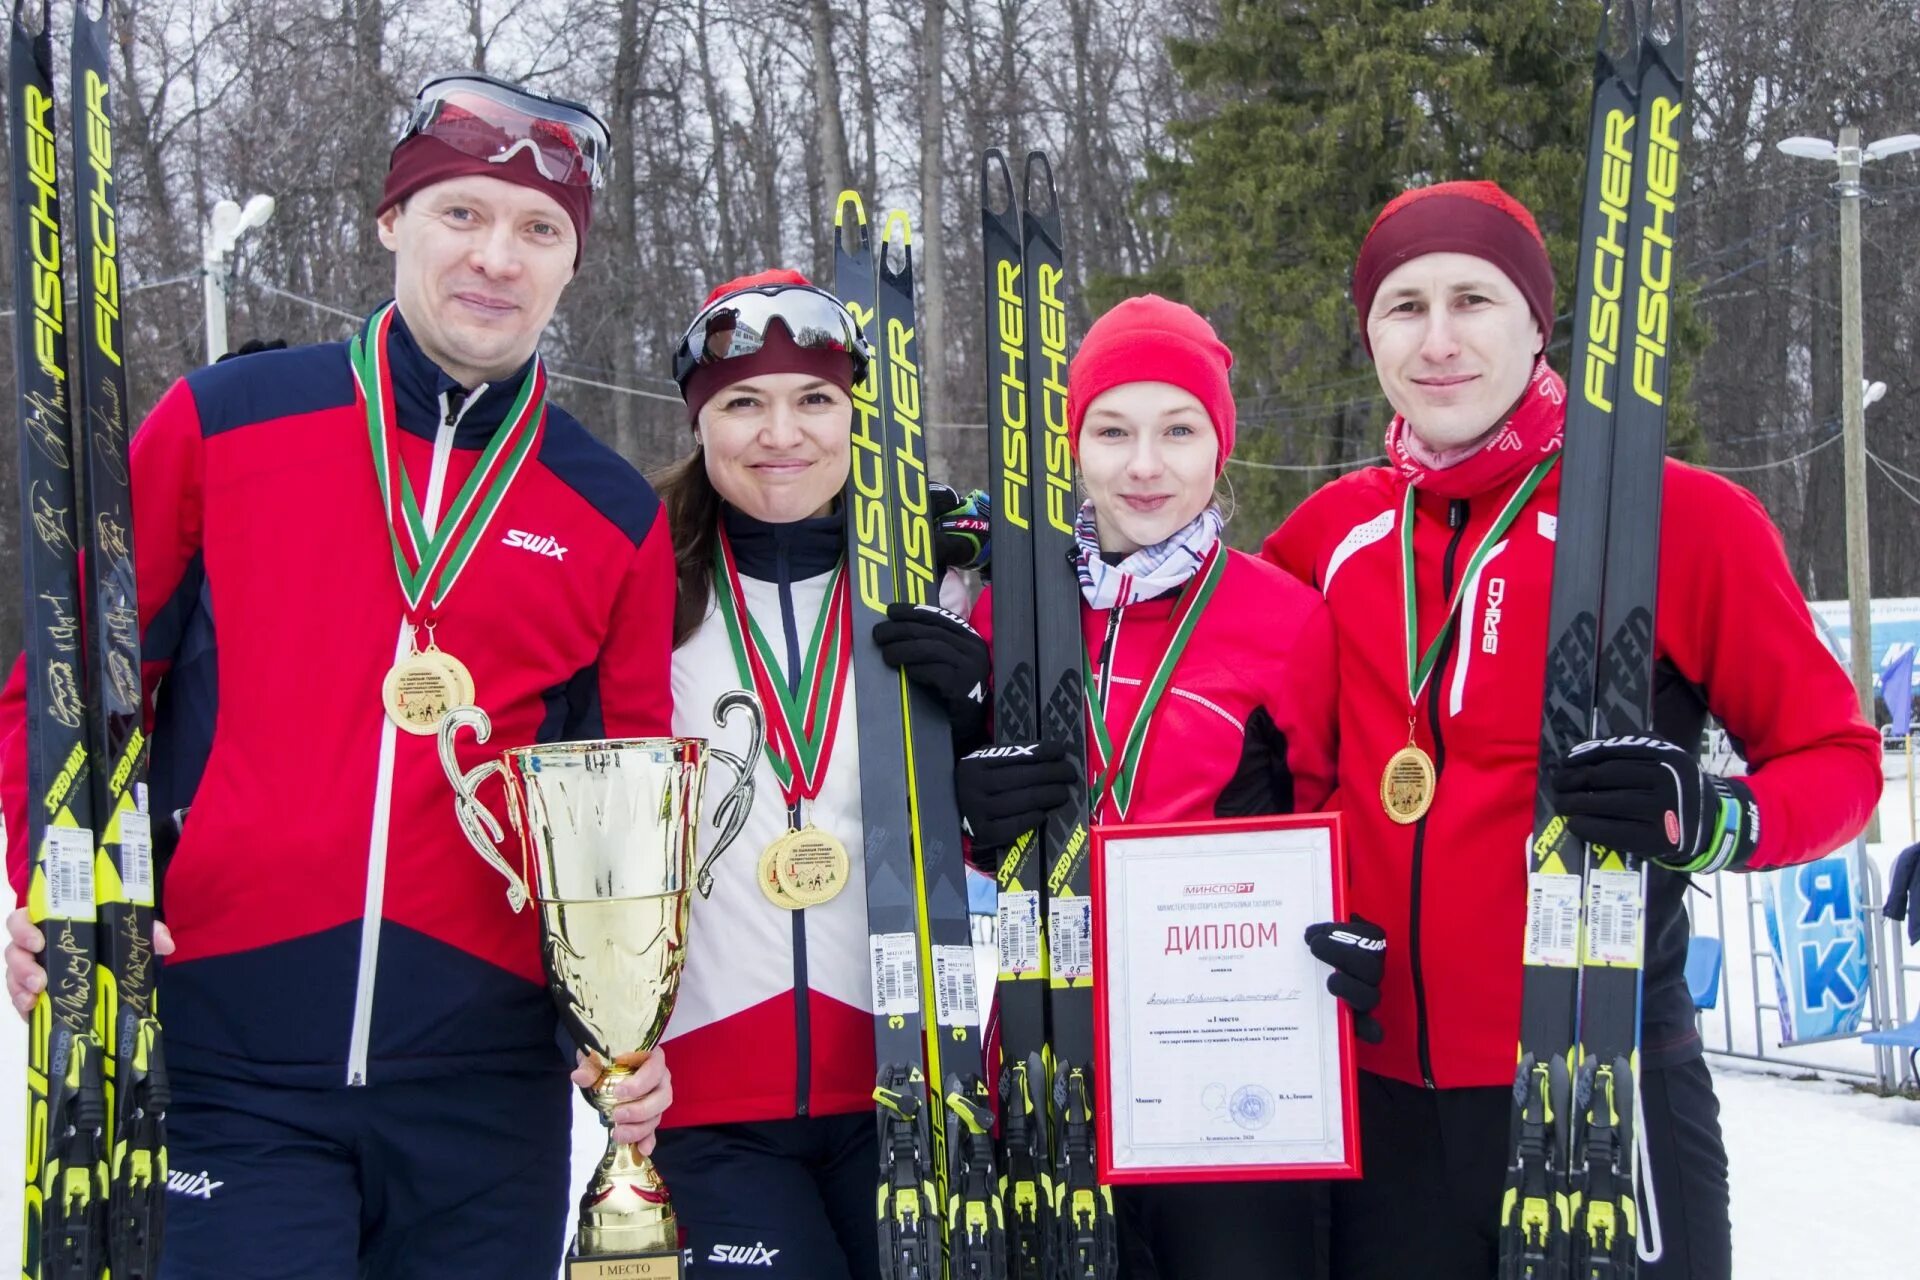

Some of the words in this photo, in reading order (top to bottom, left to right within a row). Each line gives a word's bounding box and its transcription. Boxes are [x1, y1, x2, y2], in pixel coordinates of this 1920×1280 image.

[25, 84, 65, 381] FISCHER
[84, 69, 121, 366] FISCHER
[1633, 96, 1682, 406] FISCHER
[1584, 109, 1636, 413] FISCHER
[997, 259, 1029, 530] FISCHER
[1039, 263, 1073, 535] FISCHER
[888, 317, 934, 604] FISCHER
[1482, 577, 1505, 655] BRIKO
[44, 770, 72, 815] SPEED
[64, 741, 88, 780] MAX
[109, 755, 132, 799] SPEED
[126, 726, 145, 765] MAX
[997, 845, 1022, 888] SPEED
[1048, 852, 1072, 894] SPEED
[1066, 822, 1088, 858] MAX
[1534, 815, 1564, 862] SPEED
[1184, 883, 1255, 896] МИНСПОРТ
[1165, 922, 1278, 955] ДИПЛОМ
[607, 1263, 651, 1275] МЕСТО
